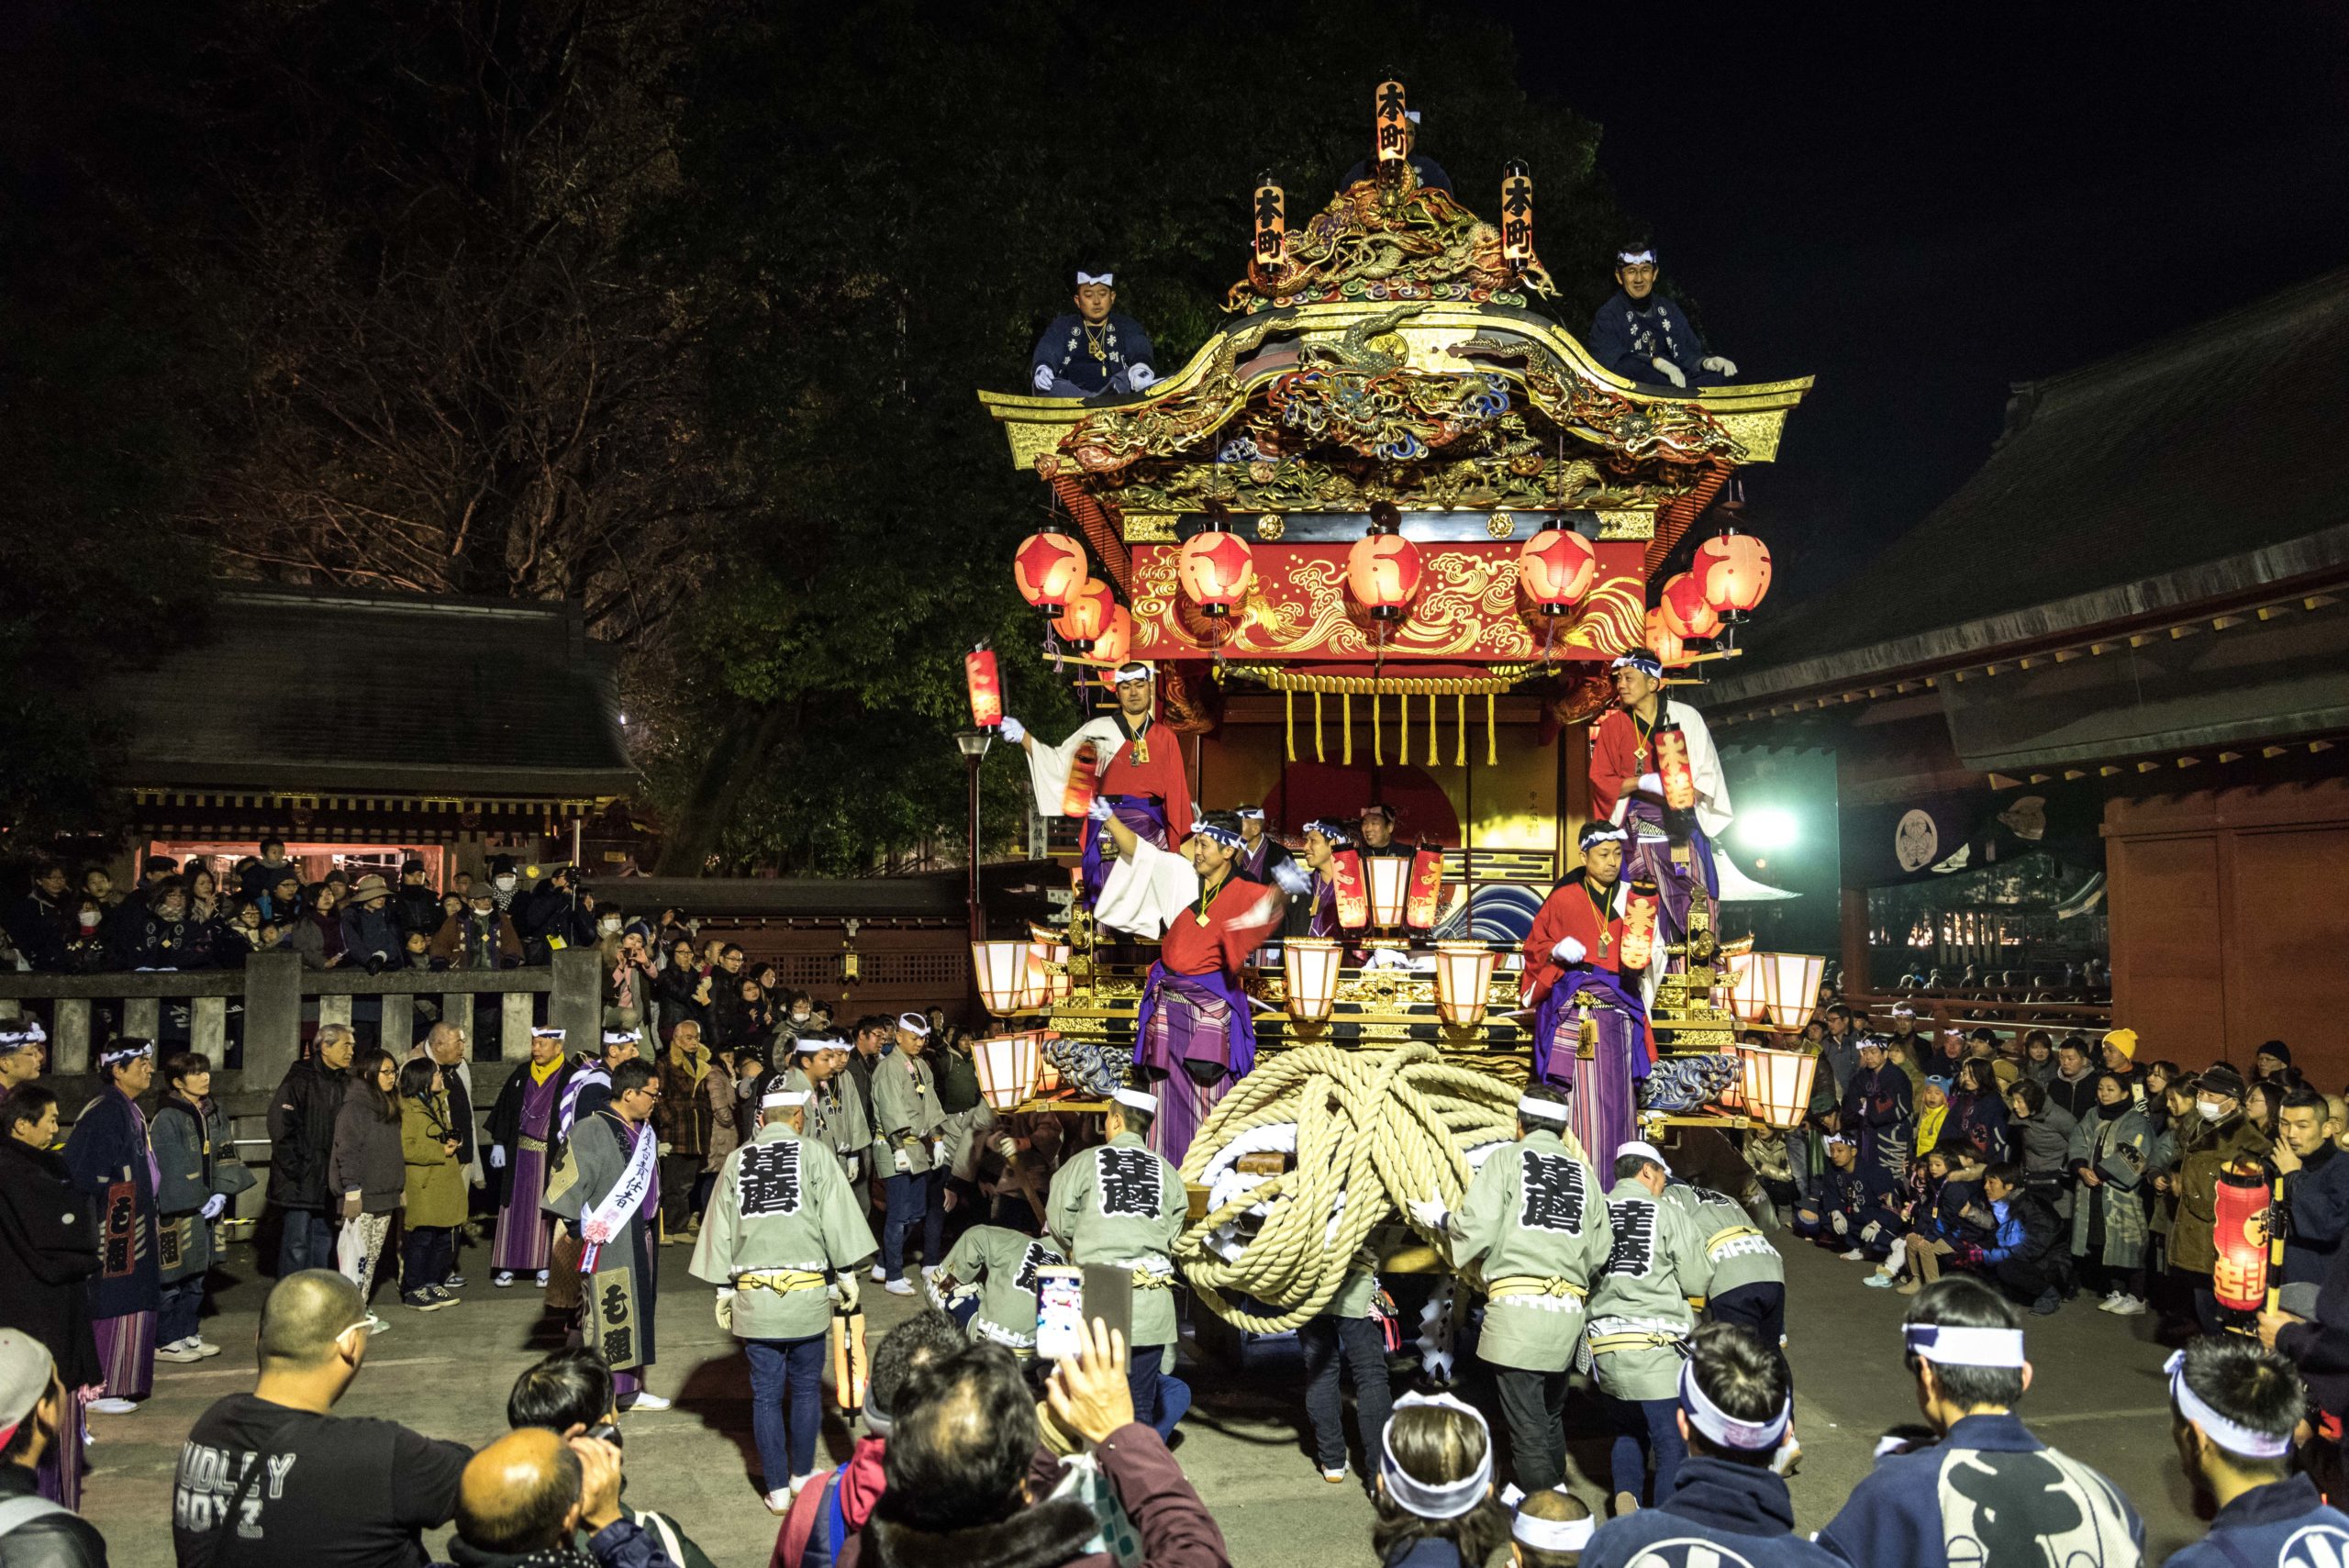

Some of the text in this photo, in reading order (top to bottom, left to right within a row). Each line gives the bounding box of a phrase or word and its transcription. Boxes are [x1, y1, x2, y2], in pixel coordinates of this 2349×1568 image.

[1377, 83, 1405, 155] 本町
[1255, 189, 1283, 257] 本町
[1503, 178, 1533, 253] 本町
[1107, 334, 1119, 363] 本町
